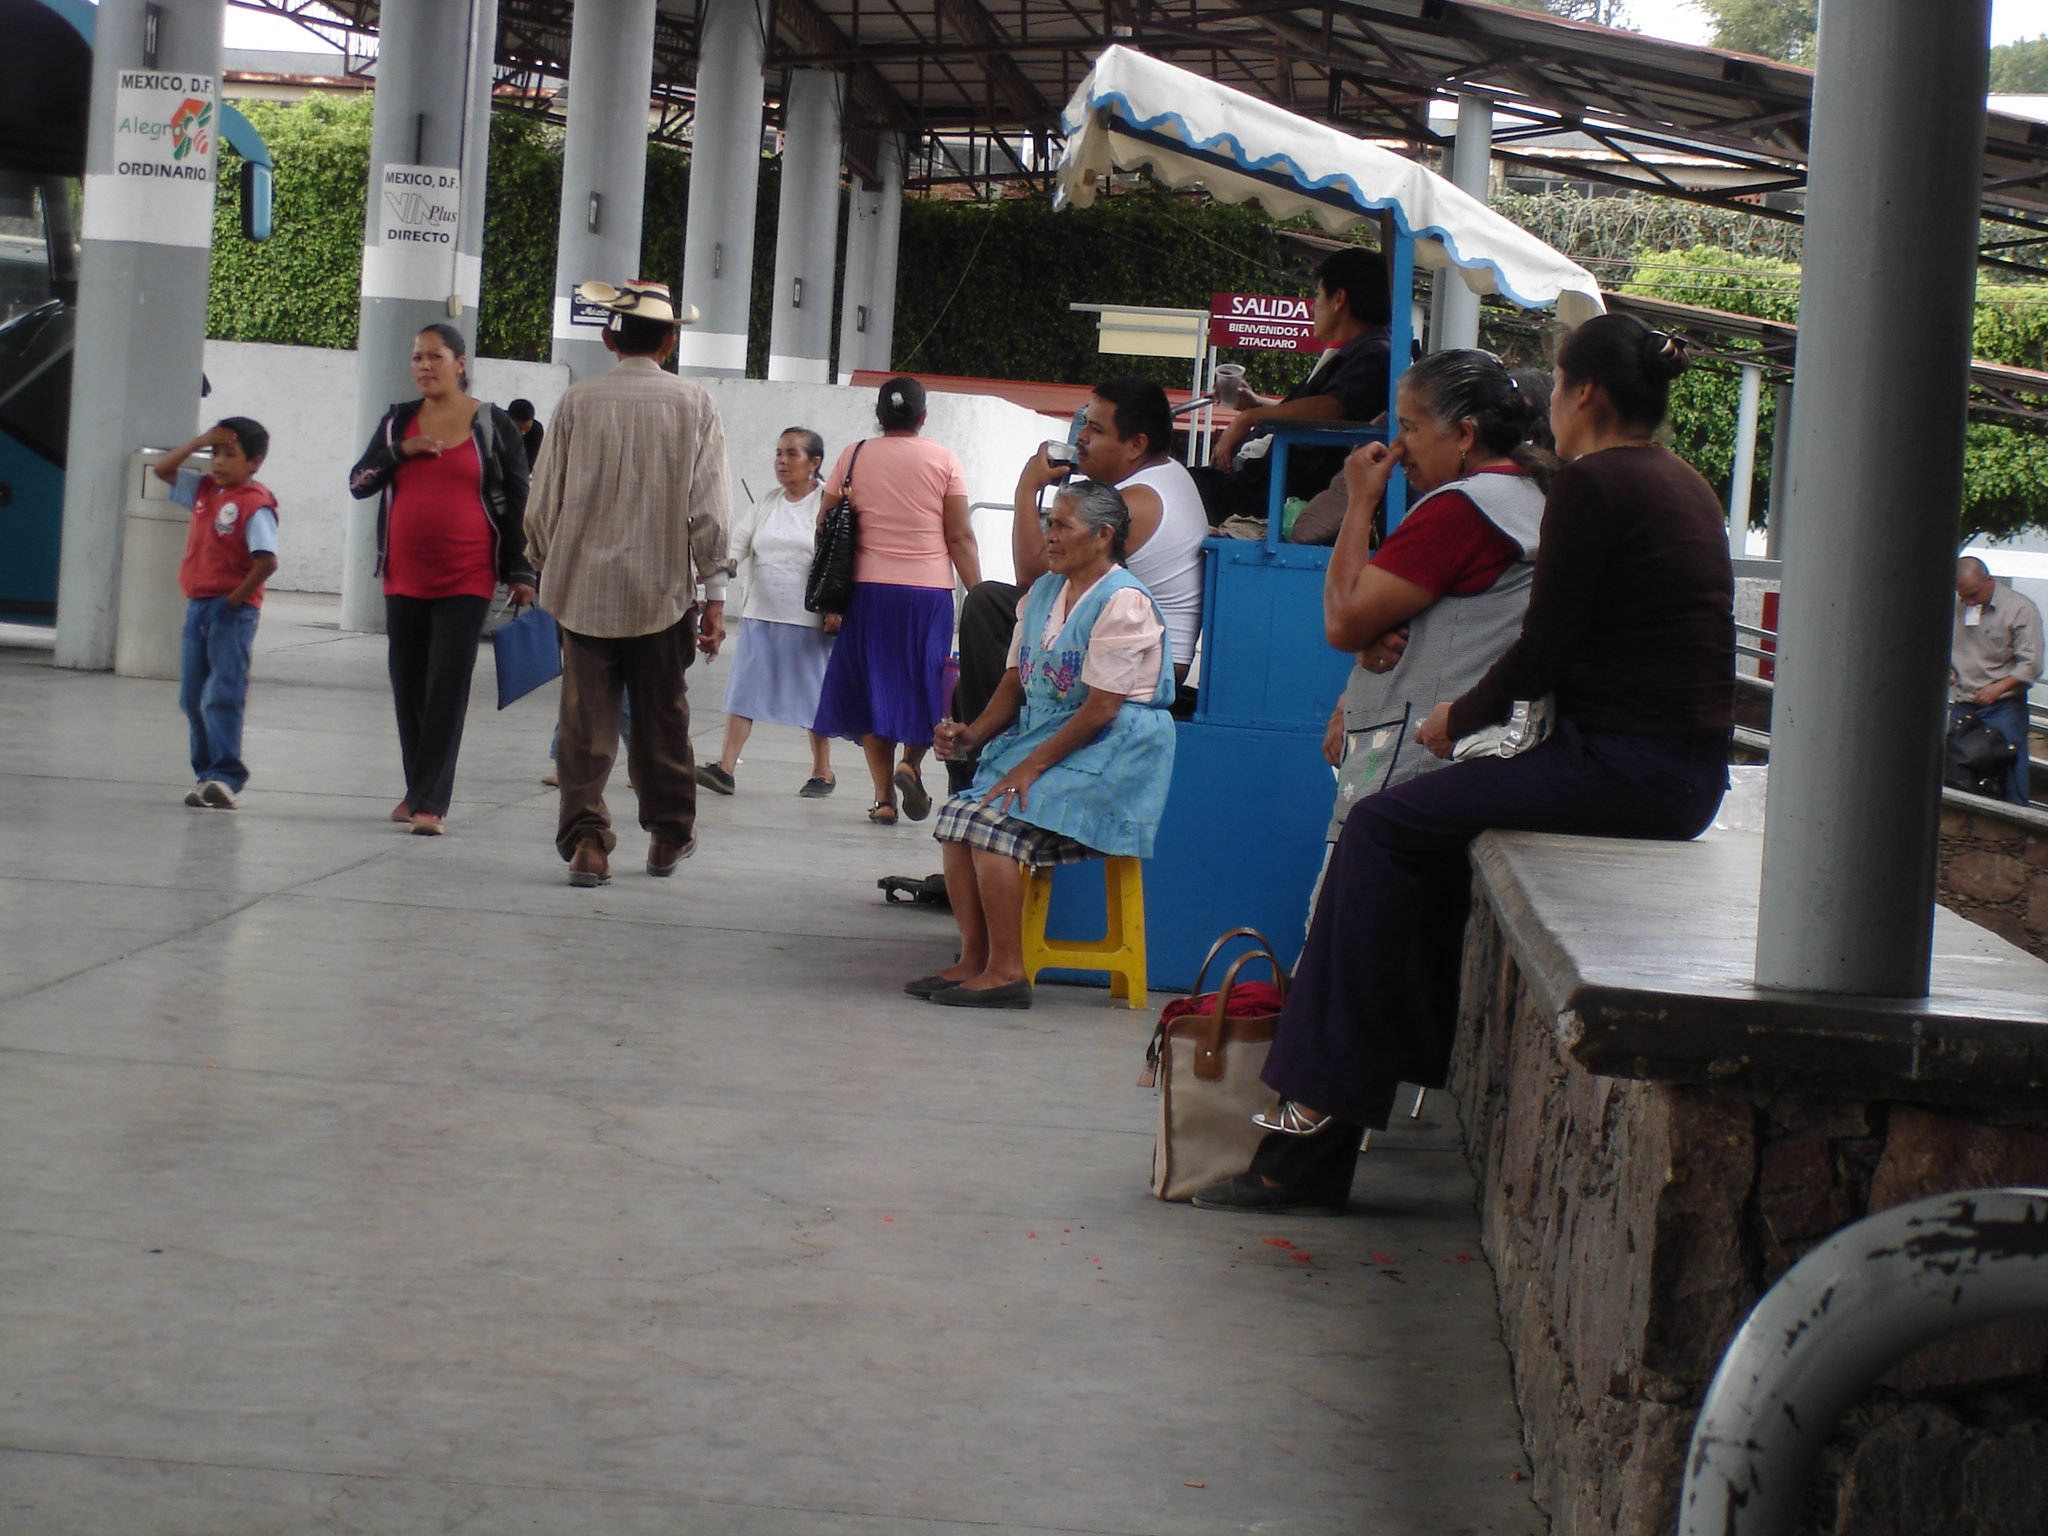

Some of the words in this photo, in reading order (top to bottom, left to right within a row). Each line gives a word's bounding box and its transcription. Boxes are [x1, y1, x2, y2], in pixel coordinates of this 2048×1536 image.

[121, 75, 187, 94] MEXICO,
[119, 162, 206, 180] ORDINARIO
[385, 172, 435, 188] MEXICO,
[439, 176, 459, 189] D.F.
[429, 205, 458, 222] Plus
[388, 229, 449, 243] DIRECTO
[1232, 298, 1309, 318] SALIDA
[1229, 324, 1298, 336] BIENVENIDOS
[1301, 329, 1310, 337] A
[1239, 337, 1297, 348] ZITACUARO
